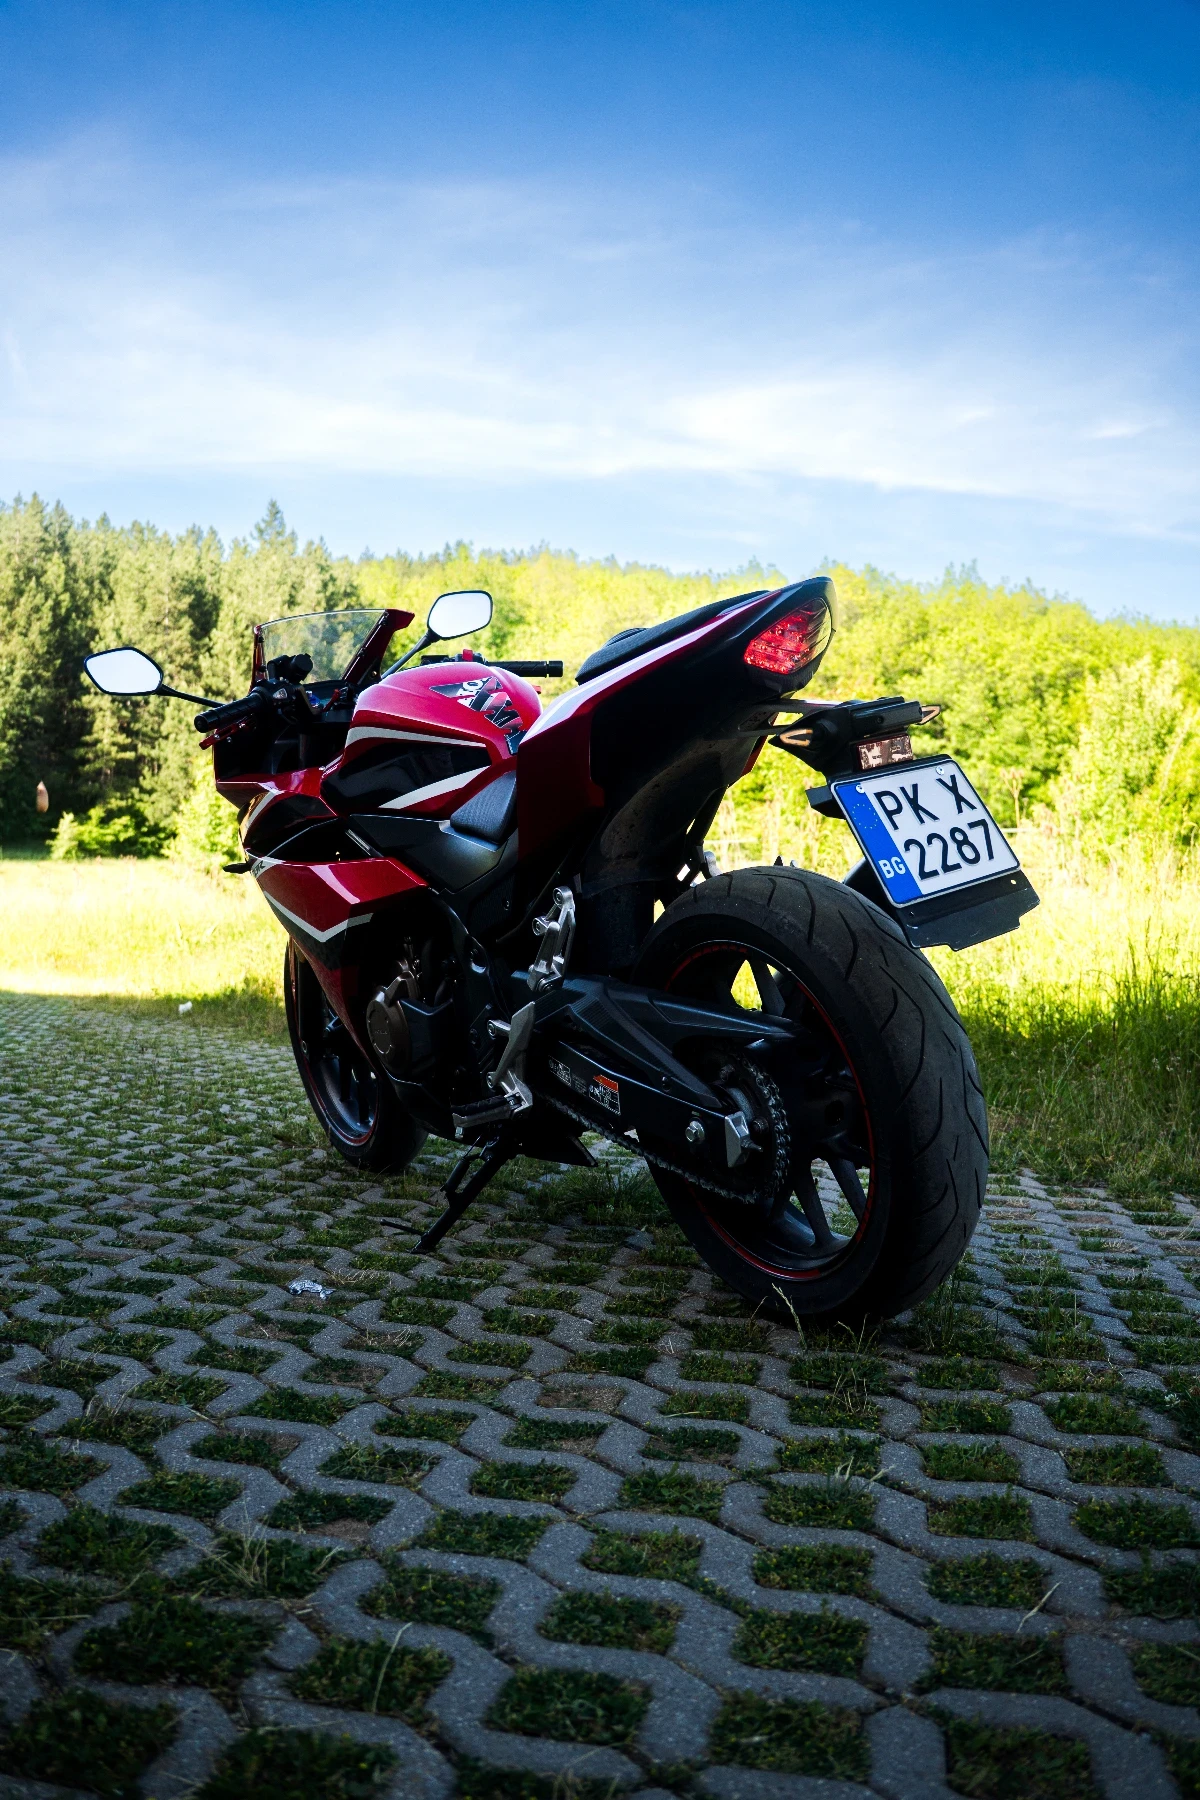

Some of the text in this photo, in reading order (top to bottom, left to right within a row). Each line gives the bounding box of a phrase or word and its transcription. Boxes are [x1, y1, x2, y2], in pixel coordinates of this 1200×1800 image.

[873, 774, 977, 831] PK X
[878, 856, 906, 879] BG
[903, 818, 995, 881] 2287
